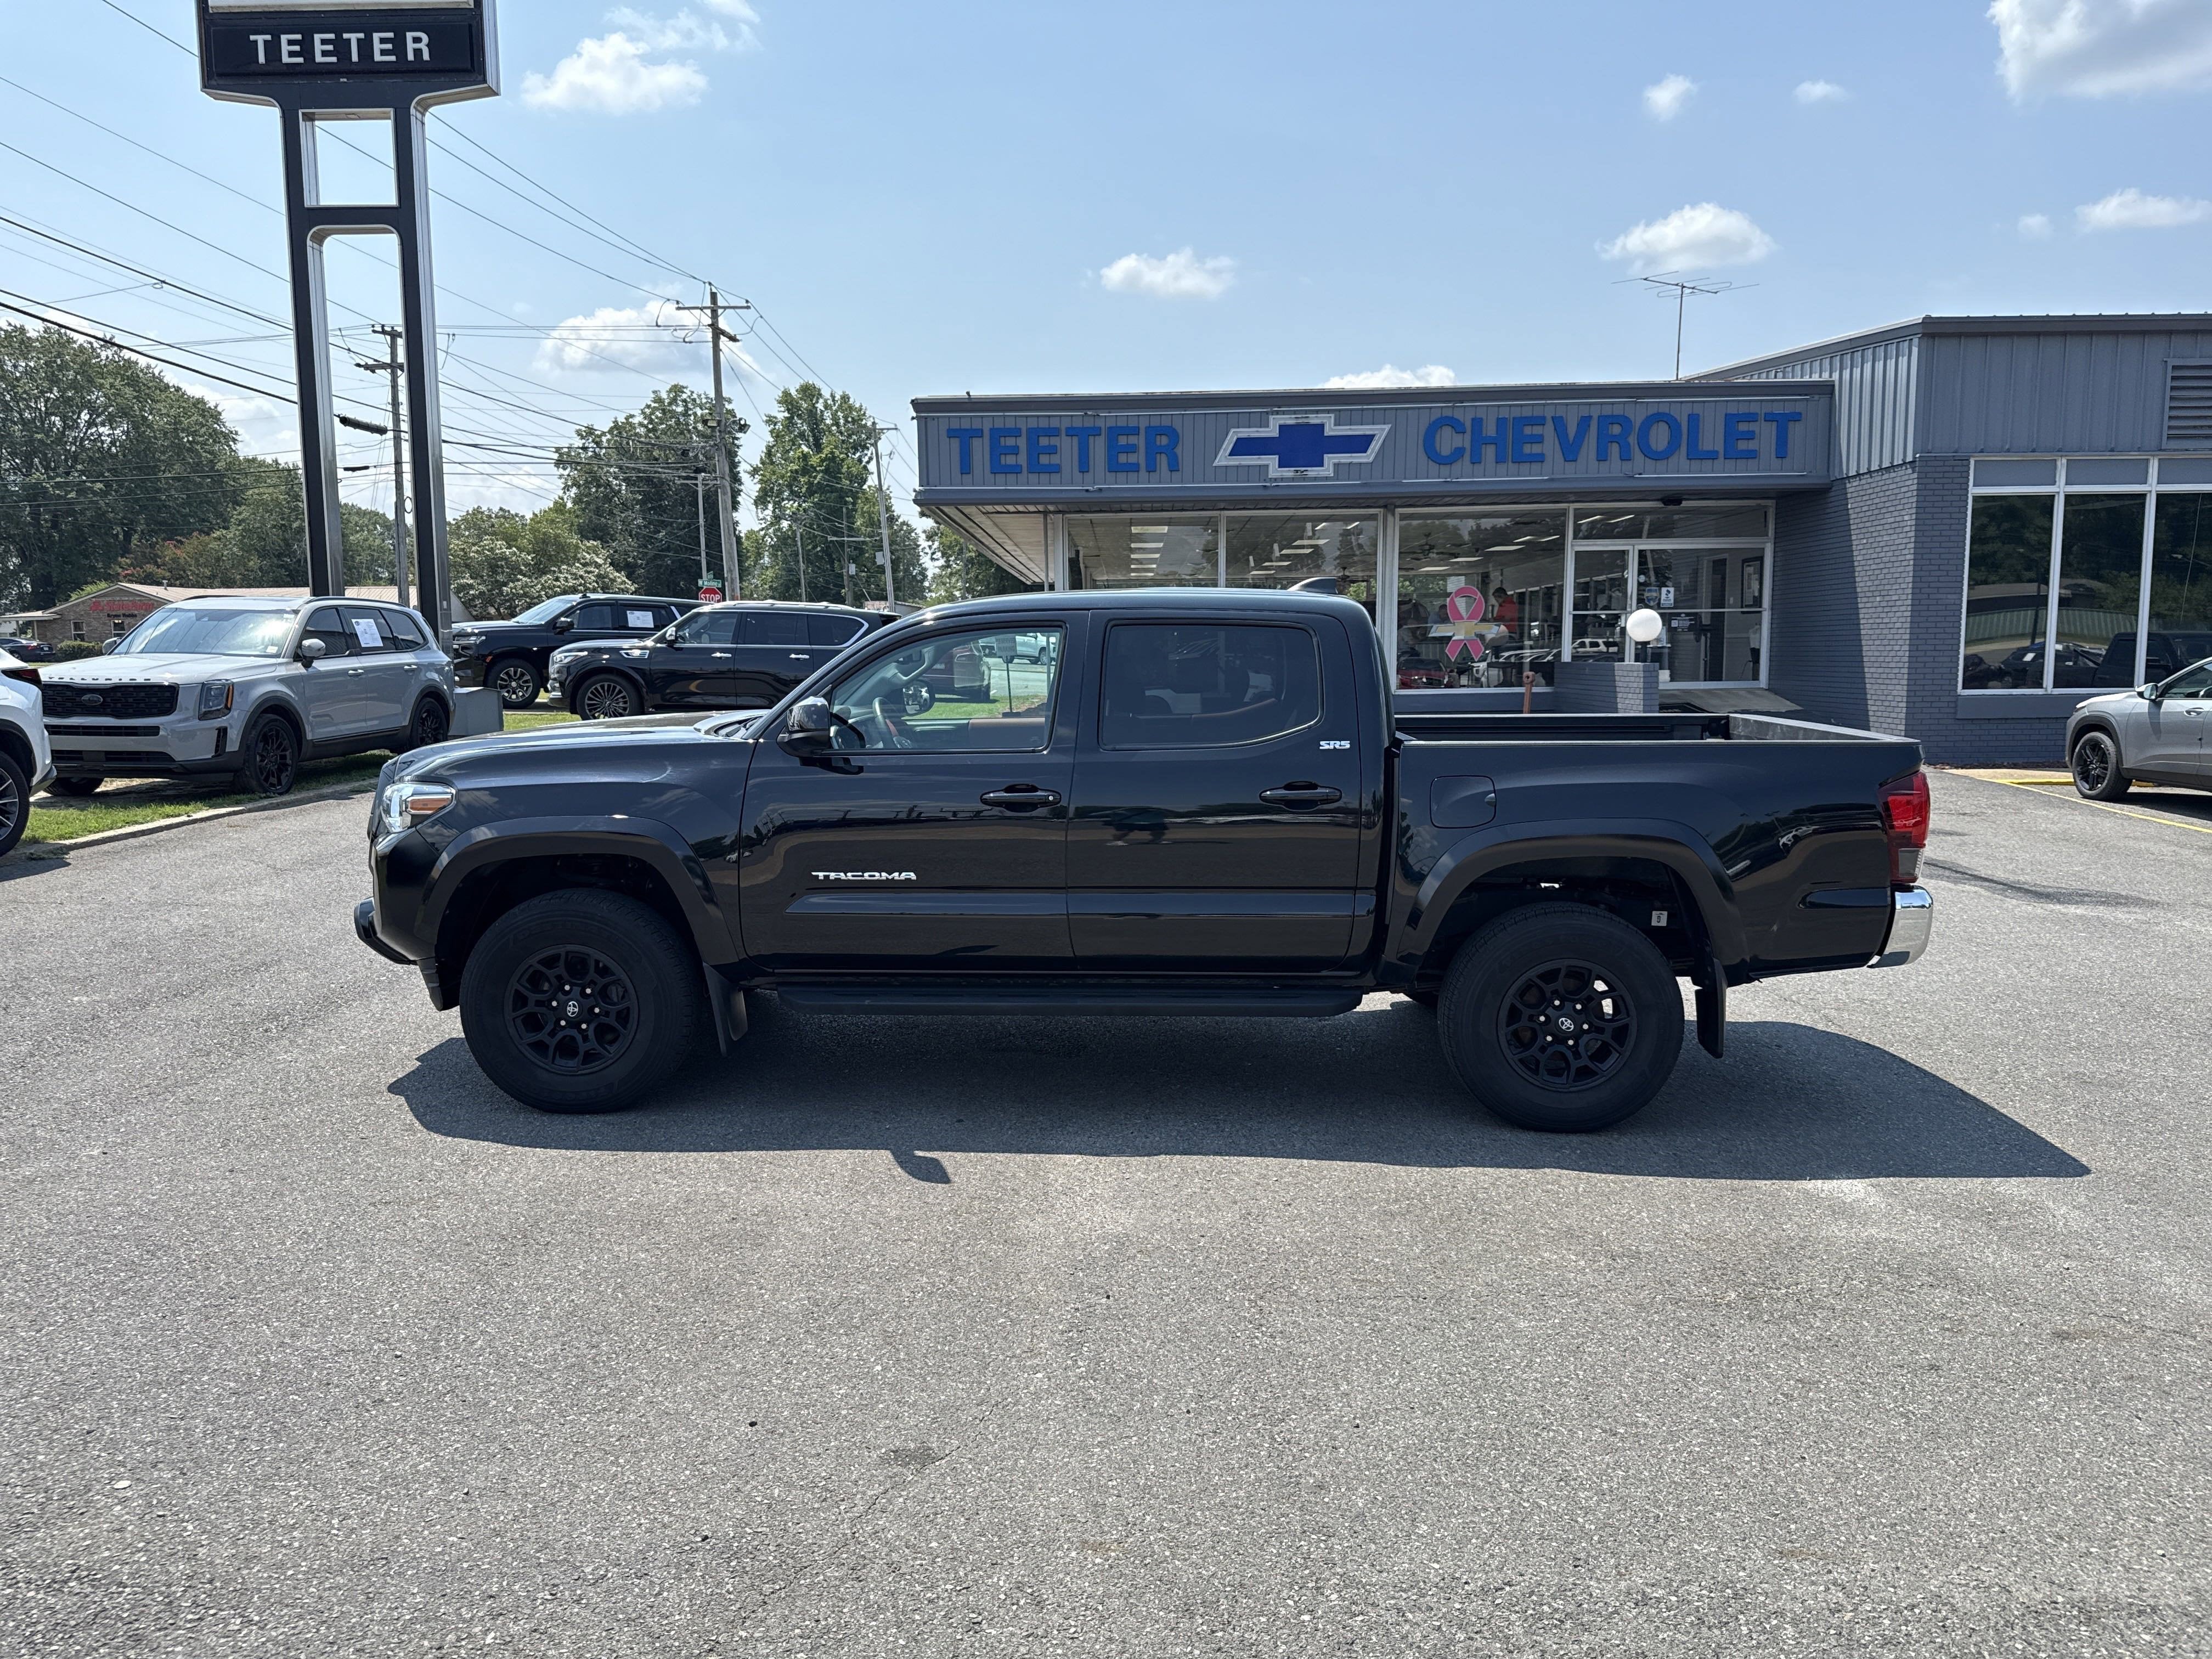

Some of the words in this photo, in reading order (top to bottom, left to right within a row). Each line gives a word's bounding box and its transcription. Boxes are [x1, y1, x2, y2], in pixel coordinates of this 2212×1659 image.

[250, 31, 430, 64] TEETER
[1423, 411, 1803, 465] CHEVROLET
[946, 425, 1180, 475] TEETER
[701, 594, 720, 603] STOP
[1319, 741, 1350, 749] SR5
[811, 872, 917, 880] TACOMA
